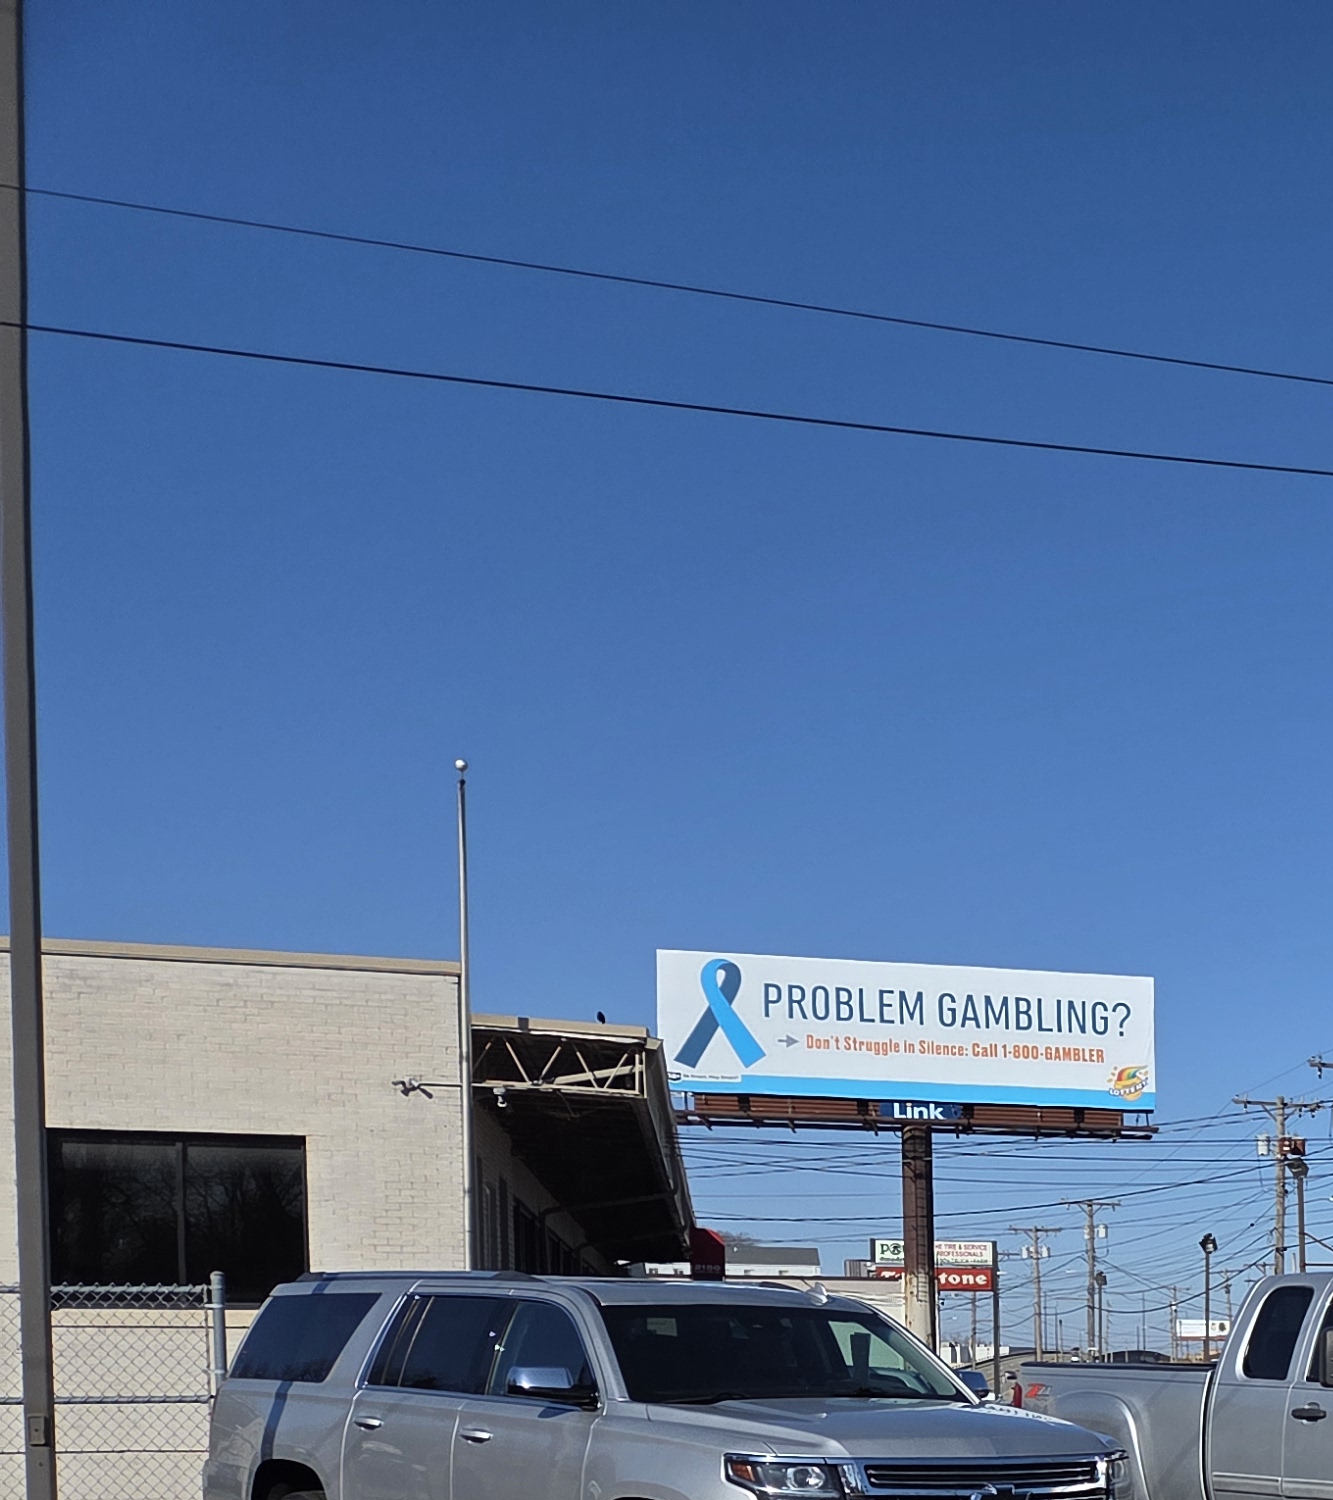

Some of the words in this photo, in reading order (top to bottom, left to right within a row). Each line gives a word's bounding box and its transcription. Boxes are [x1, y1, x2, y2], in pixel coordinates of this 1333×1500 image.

[763, 982, 925, 1026] PROBLEM
[937, 992, 1132, 1037] GAMBLING?
[806, 1034, 840, 1050] Don't
[844, 1036, 900, 1056] Struggle
[918, 1040, 969, 1057] Silence:
[972, 1042, 998, 1058] Call
[1001, 1043, 1105, 1063] 1-800-GAMBLER
[1108, 1077, 1149, 1097] LOTTERY
[893, 1102, 947, 1120] Link
